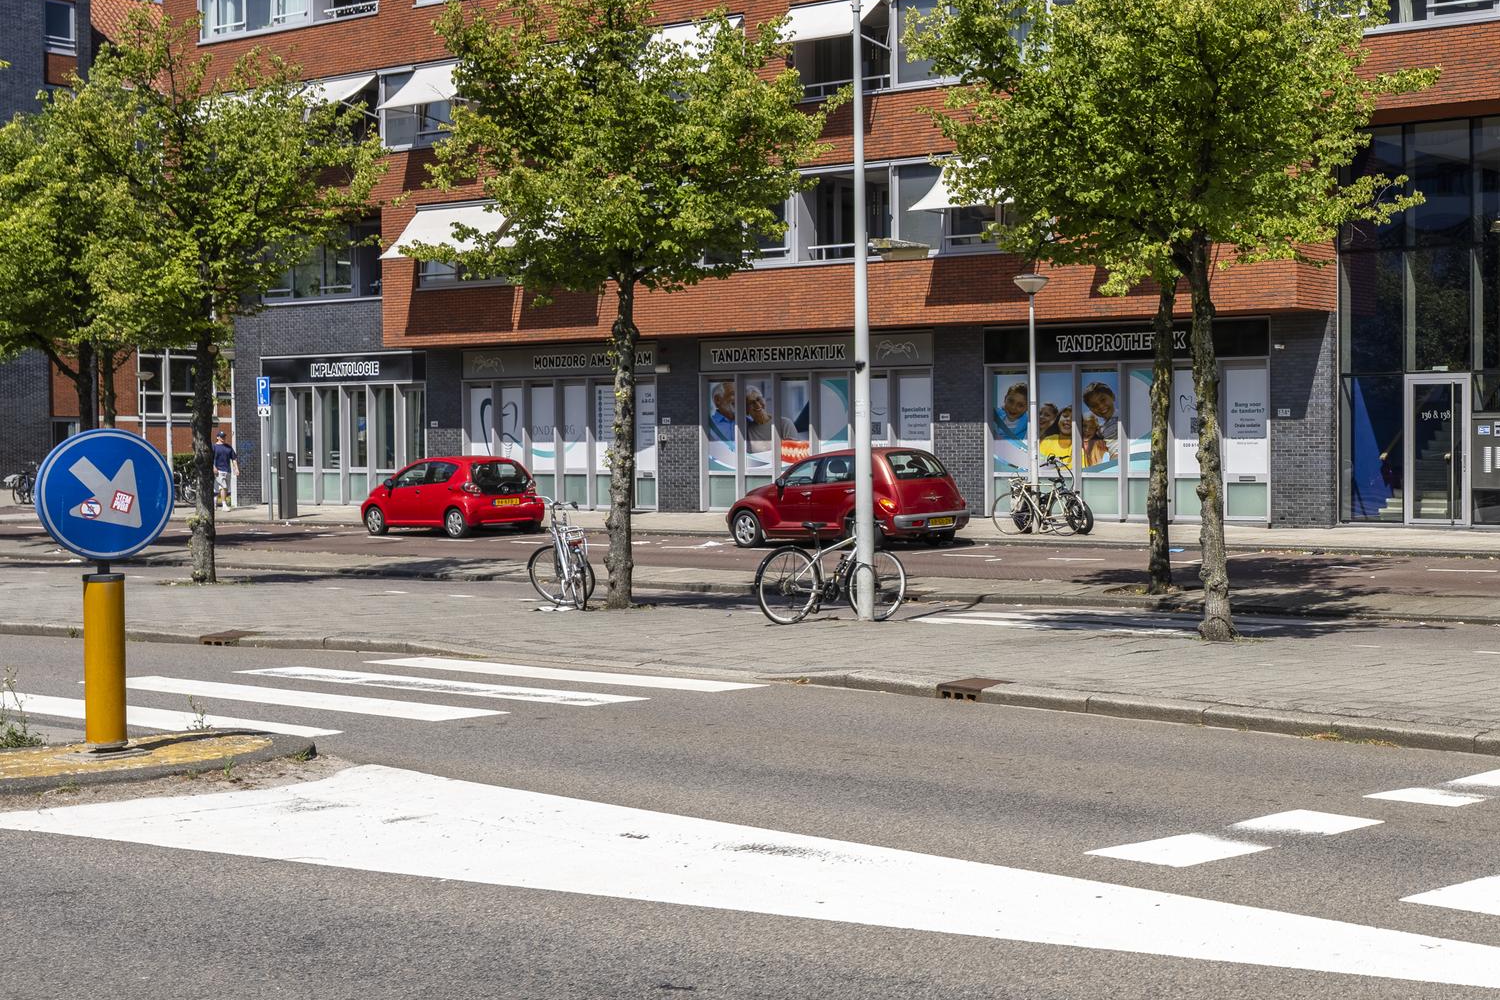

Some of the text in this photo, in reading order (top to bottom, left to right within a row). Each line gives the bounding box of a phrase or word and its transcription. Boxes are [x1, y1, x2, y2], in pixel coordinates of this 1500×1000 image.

[1056, 331, 1186, 352] TANDPROTHEK
[533, 351, 652, 370] MONDZORG AMSTAM
[711, 343, 846, 365] TANDARTSENPRAKTIJK
[310, 360, 380, 378] IMPLANTOLOGIE
[259, 379, 267, 393] P
[1433, 410, 1439, 419] &
